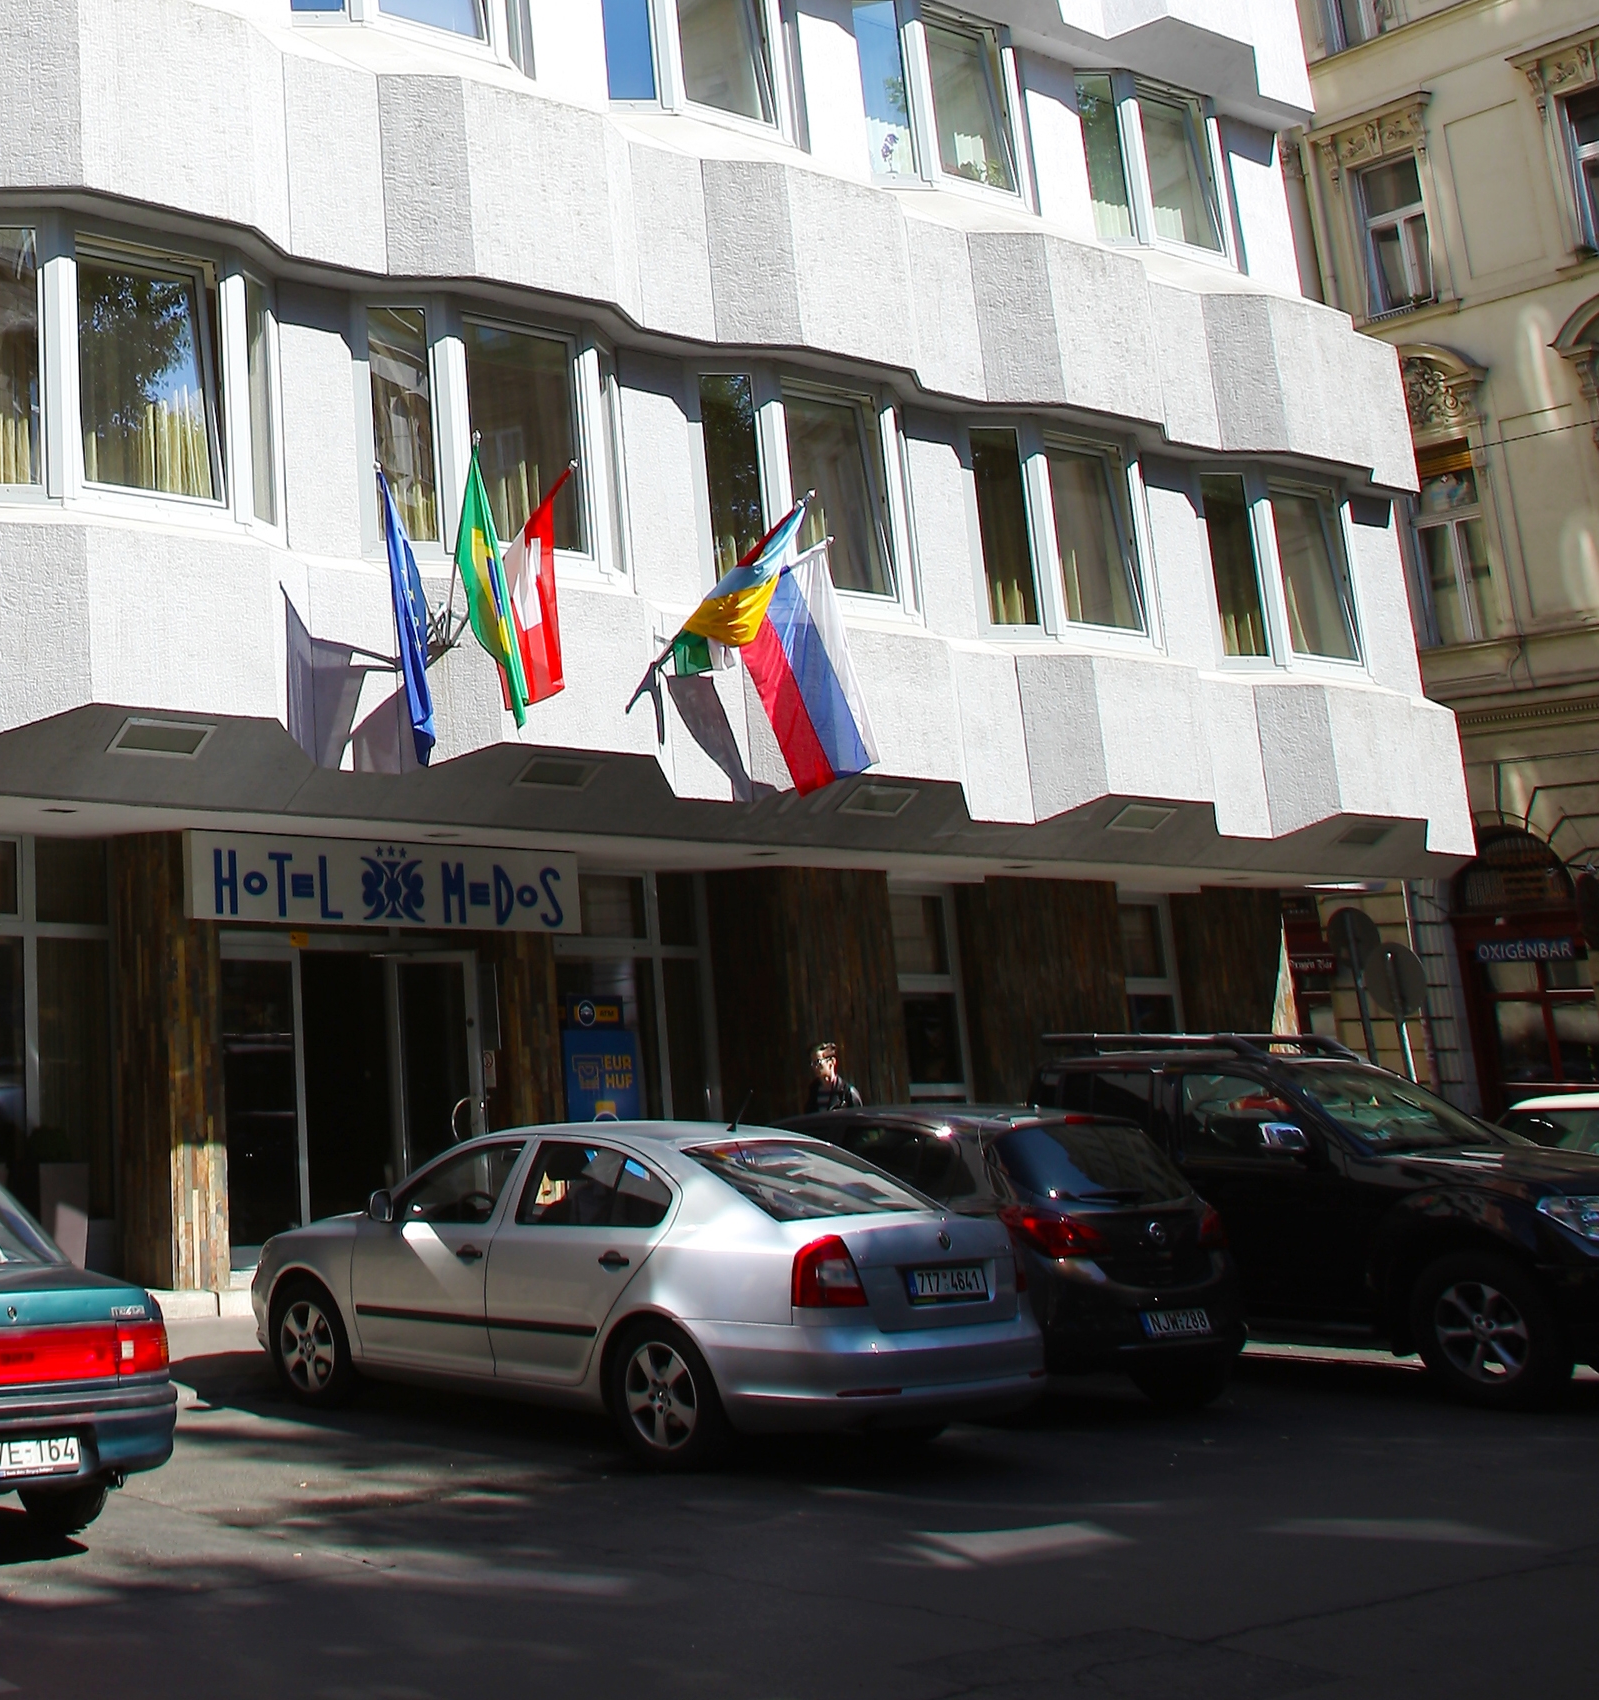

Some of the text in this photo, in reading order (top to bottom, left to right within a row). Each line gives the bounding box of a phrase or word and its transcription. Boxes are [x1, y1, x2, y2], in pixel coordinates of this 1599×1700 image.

[213, 848, 564, 928] HOTEL MEDOS
[604, 1055, 632, 1071] EUR
[605, 1073, 633, 1089] HUF
[950, 1270, 981, 1292] 4641
